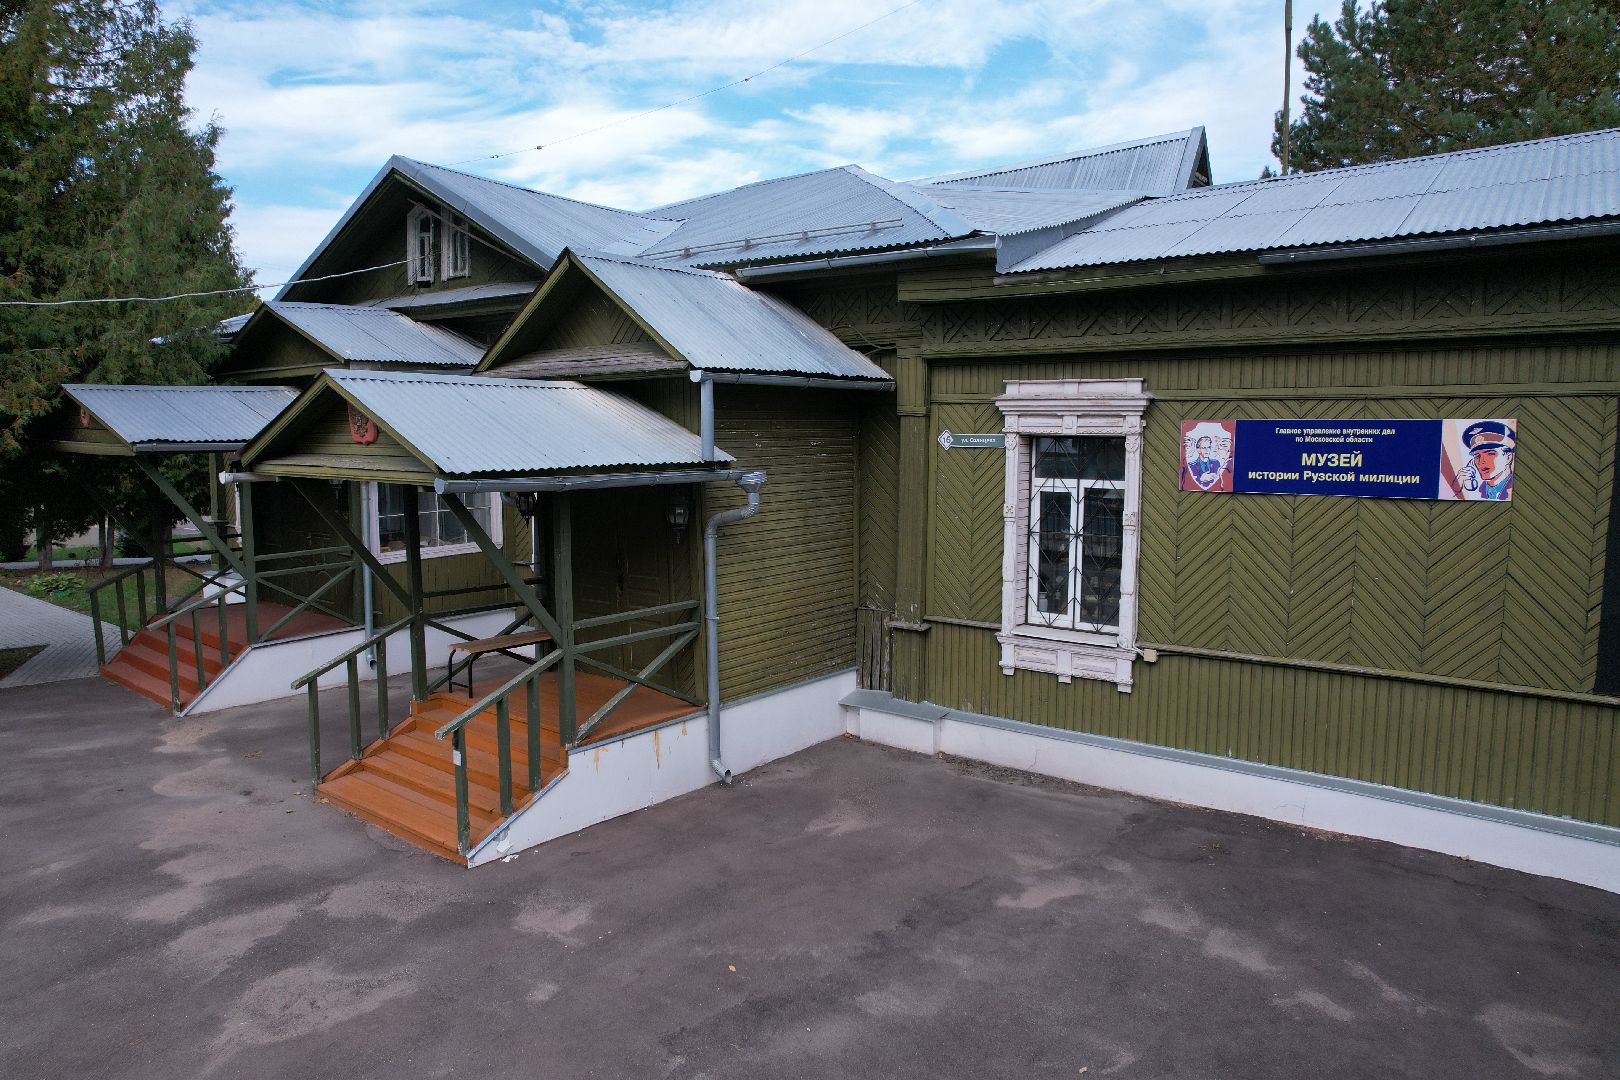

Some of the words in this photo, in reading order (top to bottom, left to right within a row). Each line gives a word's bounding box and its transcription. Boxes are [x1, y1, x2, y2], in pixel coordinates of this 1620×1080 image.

[1275, 427, 1302, 435] Главное
[1303, 428, 1341, 436] управление
[1342, 428, 1380, 436] внутренних
[1381, 428, 1396, 436] дел
[943, 436, 951, 444] 16
[1305, 435, 1345, 443] Московской
[1345, 435, 1373, 443] области
[1301, 450, 1363, 468] МУЗЕЙ
[1248, 471, 1300, 482] истории
[1303, 470, 1356, 483] Рузской
[1359, 474, 1420, 485] милиции
